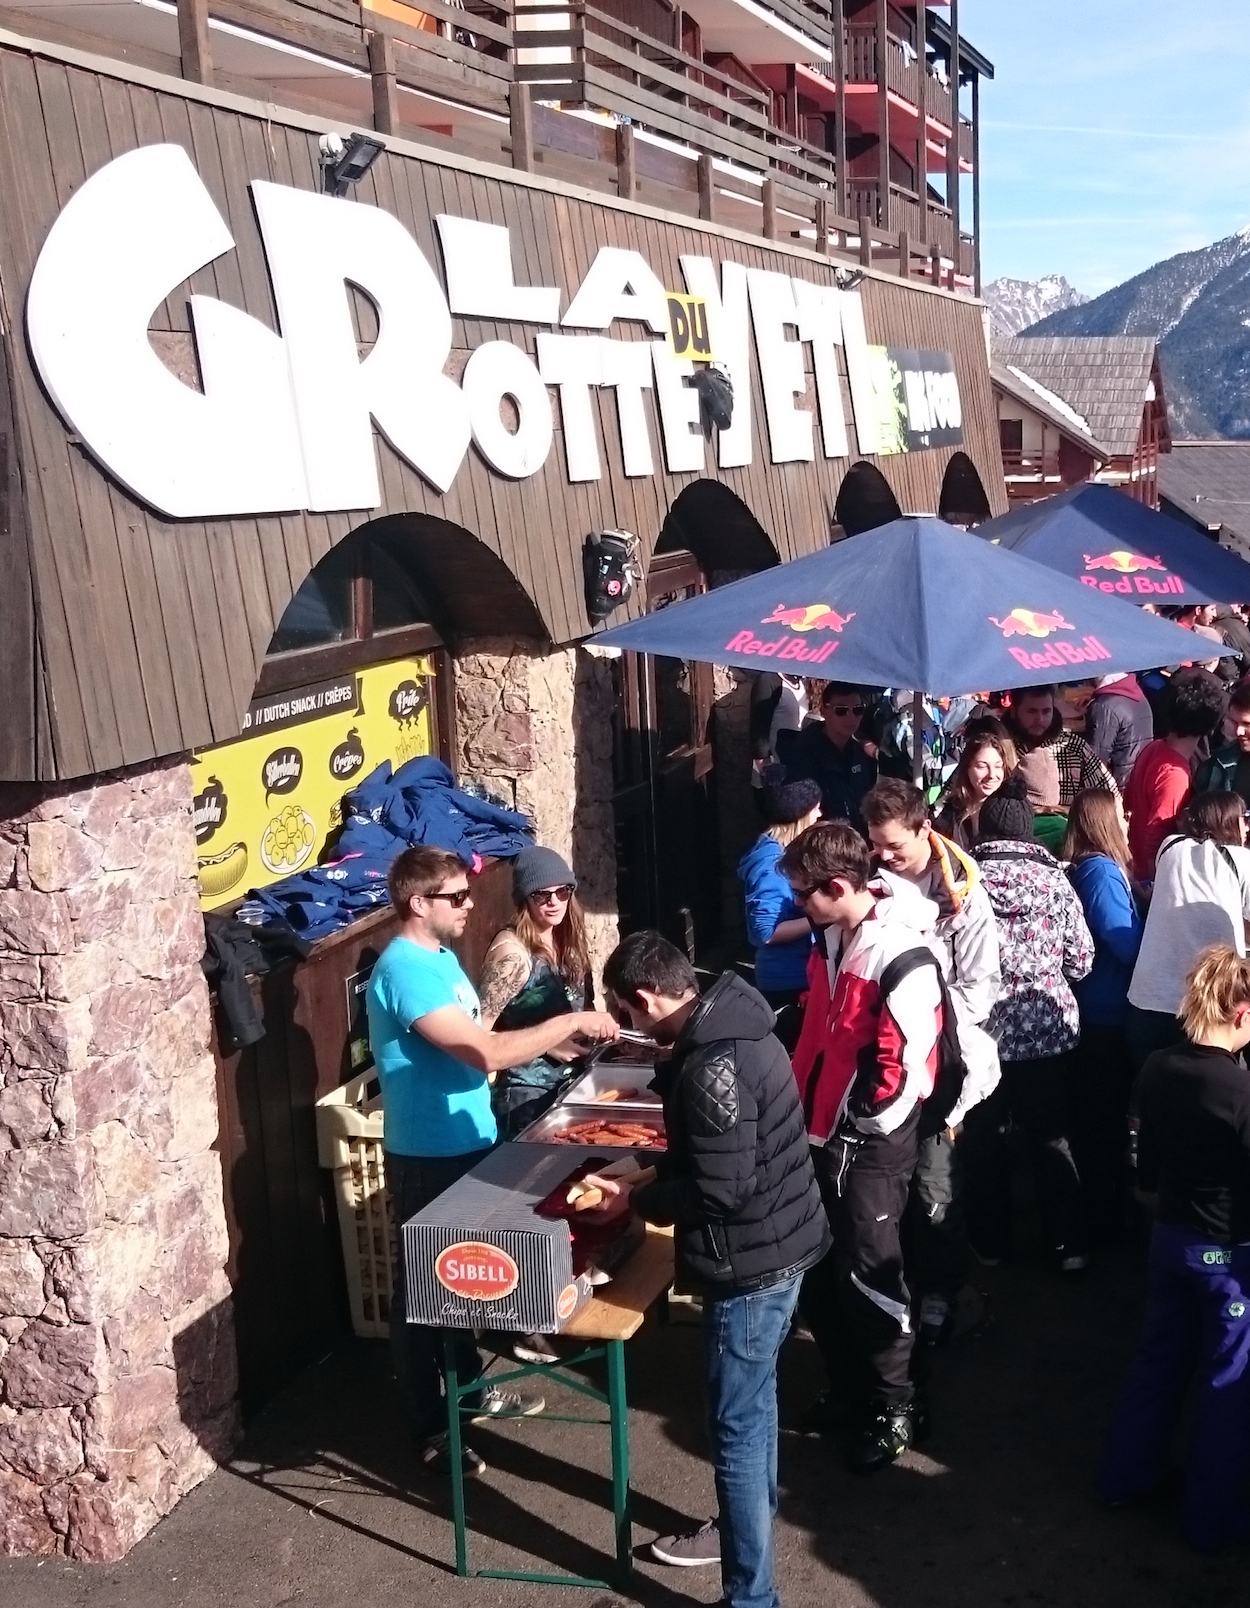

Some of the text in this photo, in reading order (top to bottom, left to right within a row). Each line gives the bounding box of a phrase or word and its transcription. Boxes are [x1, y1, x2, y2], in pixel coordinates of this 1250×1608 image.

[28, 143, 879, 518] LA GROTTE DU YETI
[1080, 576, 1184, 594] Red Bull
[725, 630, 840, 664] Red Bull
[1008, 636, 1111, 670] Red Bull
[264, 704, 290, 723] DUTCH
[291, 696, 317, 715] SNACK
[325, 685, 352, 705] CRÊPES
[396, 689, 420, 713] Frite
[333, 751, 363, 774] Crêpes
[446, 1259, 508, 1282] SIBELL
[441, 1302, 519, 1320] Chips et Snacks
